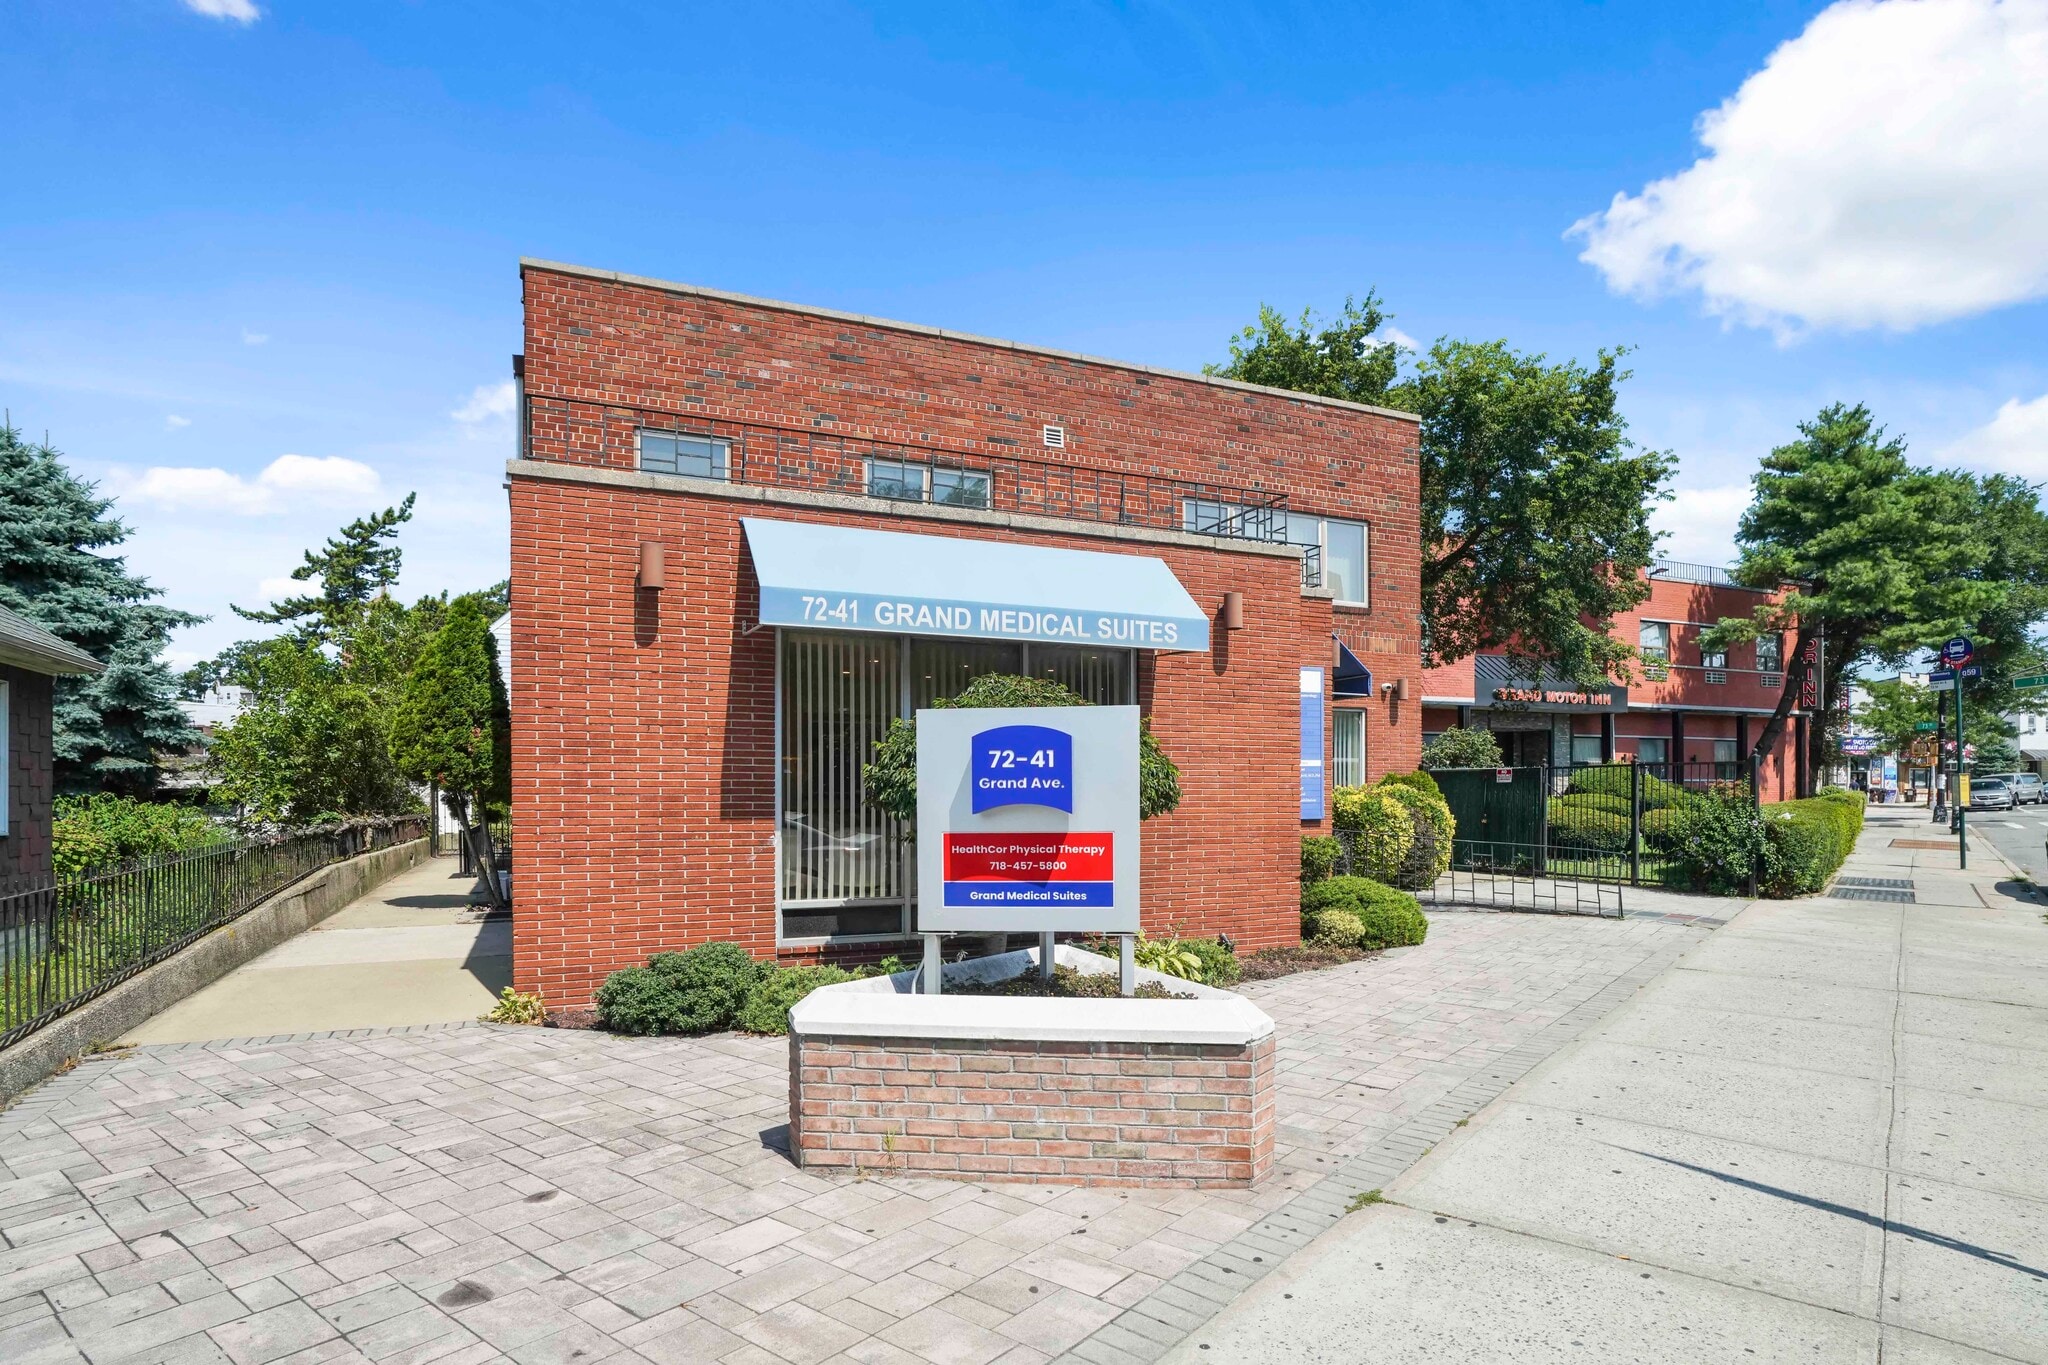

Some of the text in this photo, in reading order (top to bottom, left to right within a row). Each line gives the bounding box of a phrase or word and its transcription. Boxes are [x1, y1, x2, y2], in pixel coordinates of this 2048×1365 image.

[802, 596, 1178, 644] 72-41 GRAND MEDICAL SUITES
[2034, 677, 2045, 685] 73
[1803, 668, 1818, 707] INN
[1546, 690, 1587, 705] MOTOR
[1590, 693, 1611, 705] INN
[988, 750, 1055, 769] 72-41
[979, 777, 1065, 789] Grand Ave.
[951, 844, 1105, 856] HealthCor Physical Therapy
[989, 861, 1067, 871] 718-457-5800
[970, 891, 1087, 901] Grand Medical Suites
